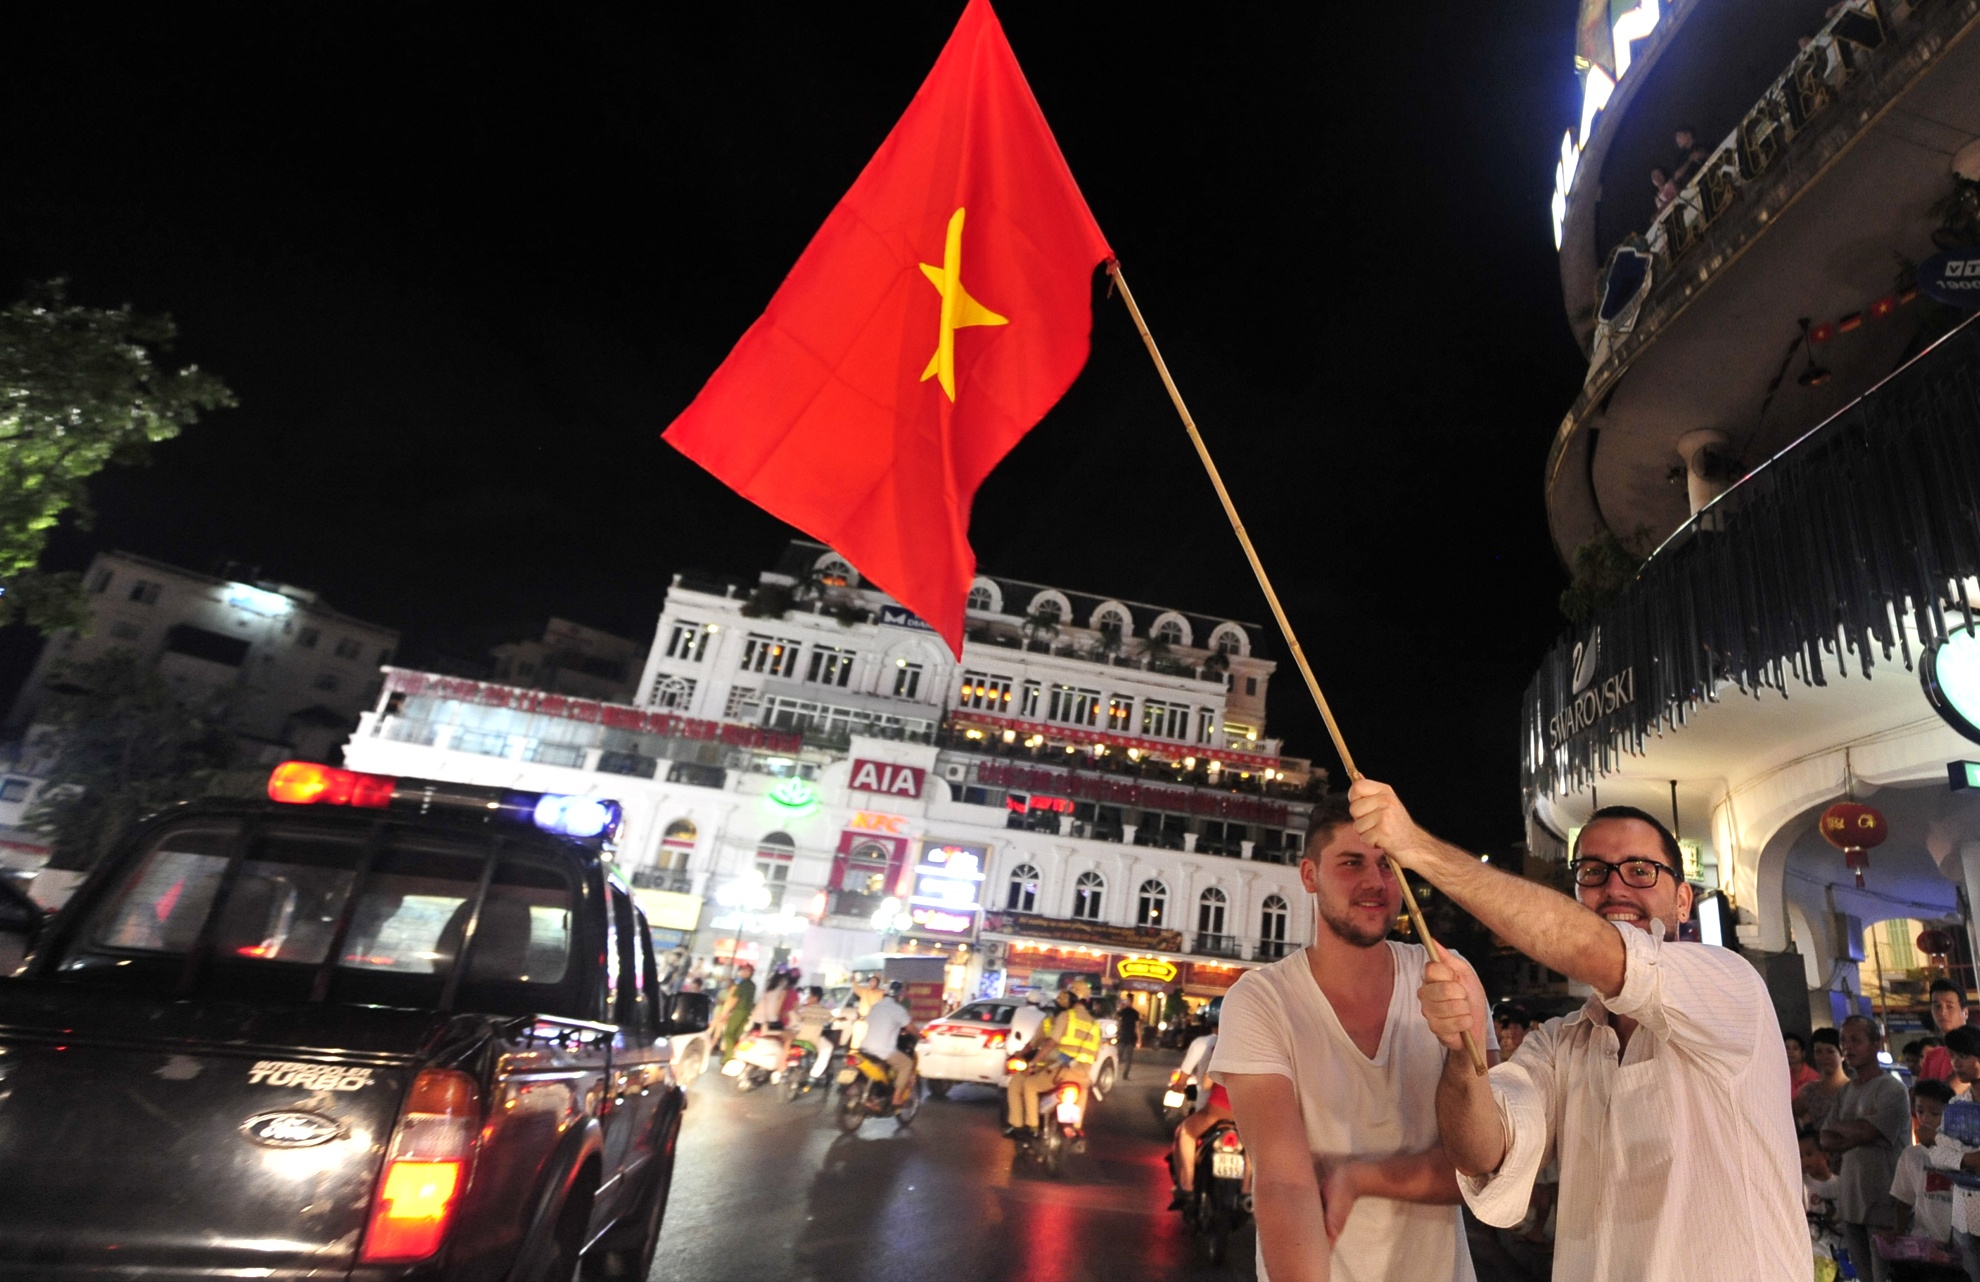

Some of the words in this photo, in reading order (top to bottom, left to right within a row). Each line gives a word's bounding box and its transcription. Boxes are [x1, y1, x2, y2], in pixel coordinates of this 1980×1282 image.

[1661, 0, 1906, 268] LEGEN
[1549, 666, 1635, 750] SWAROVSKI
[852, 762, 917, 796] AIA
[851, 811, 906, 834] KFC
[248, 1070, 370, 1092] TURBO
[251, 1060, 374, 1079] INTERCOOLER
[1924, 1192, 1954, 1203] VIETNA
